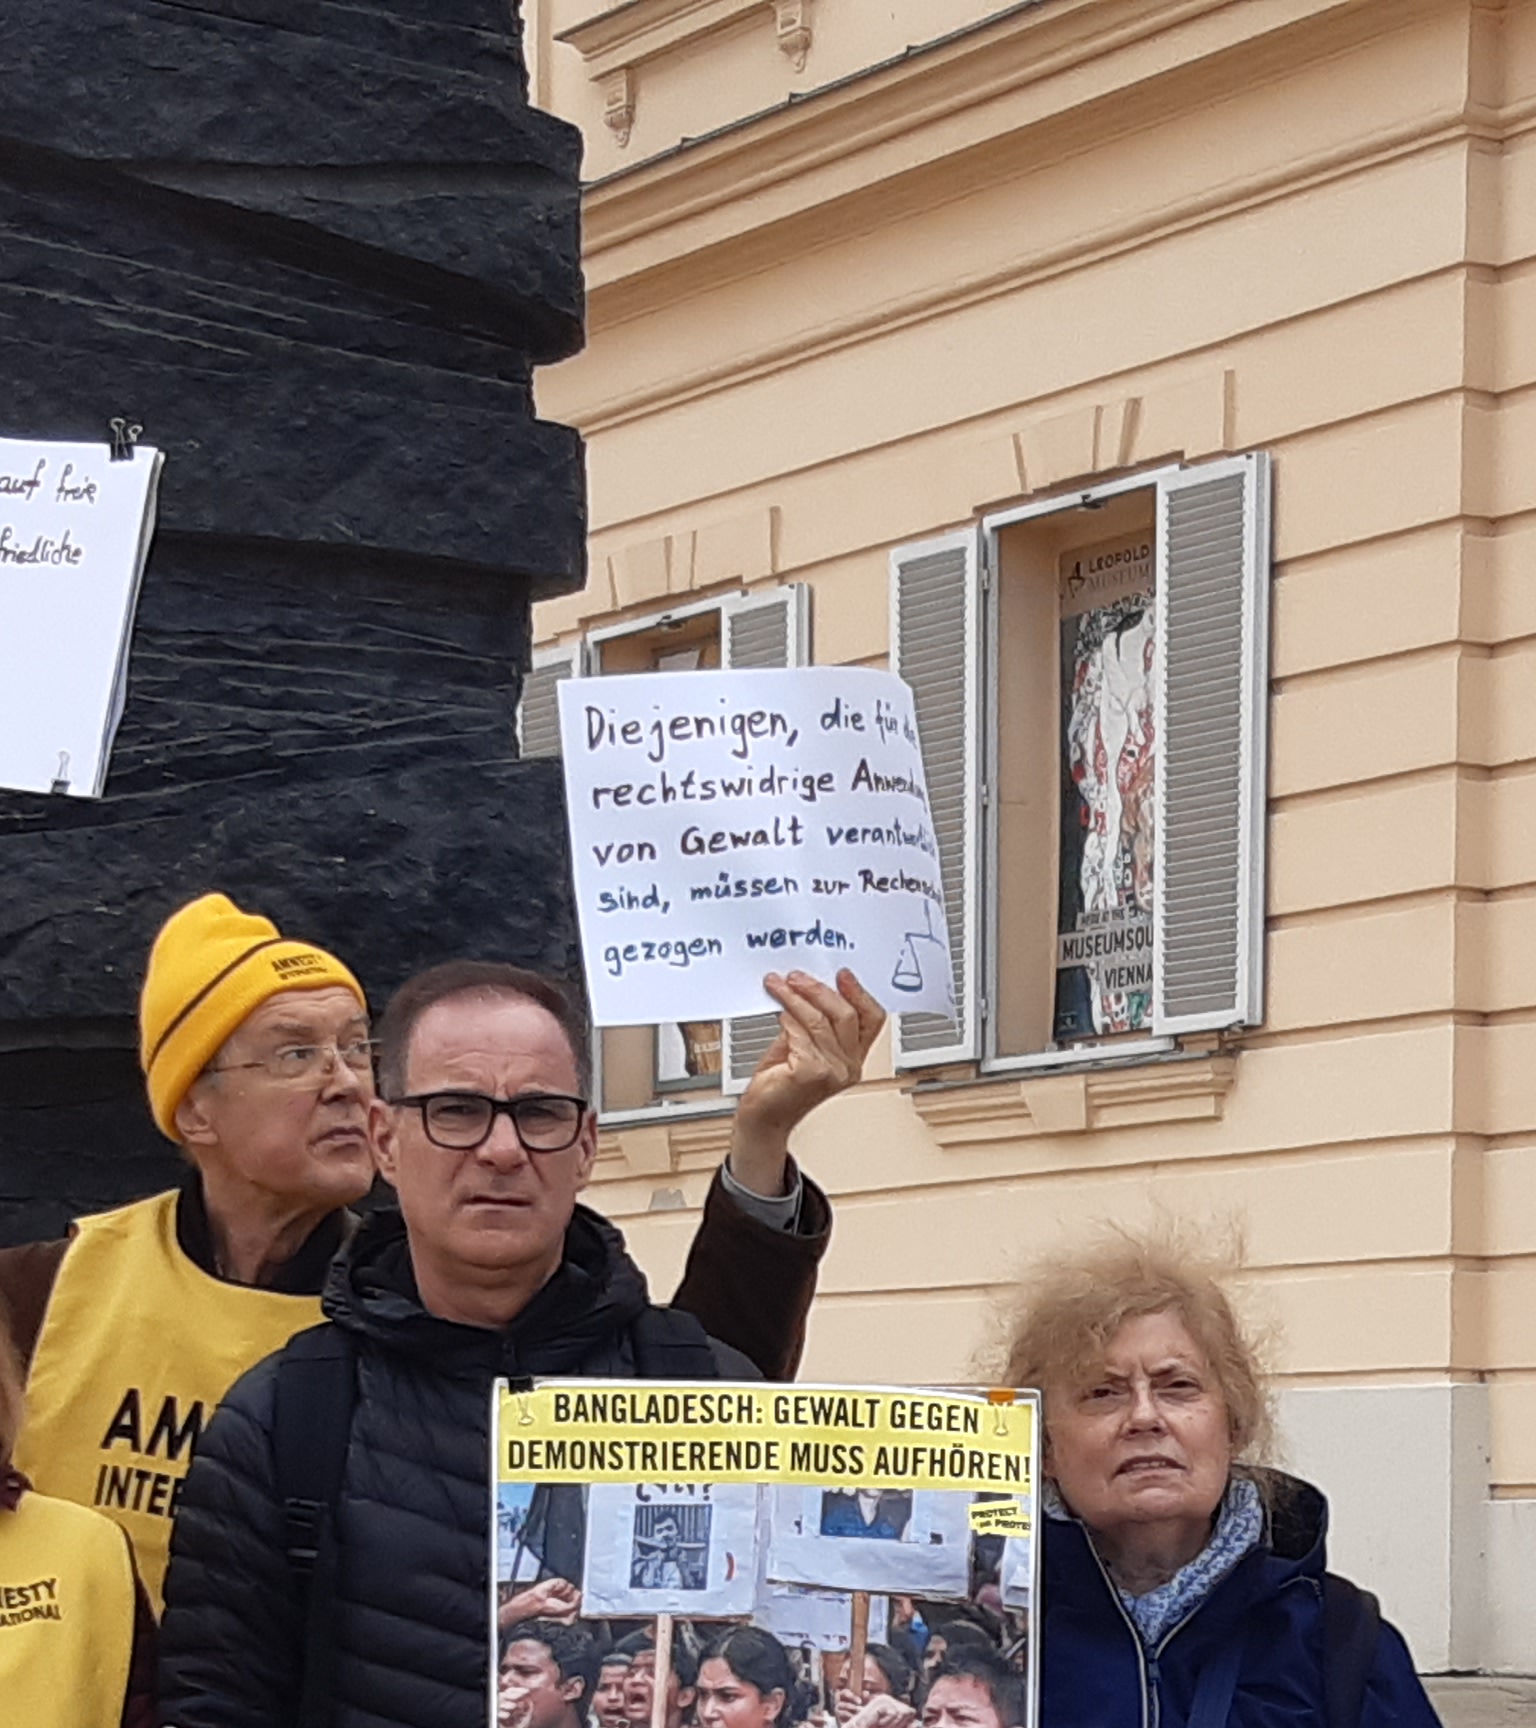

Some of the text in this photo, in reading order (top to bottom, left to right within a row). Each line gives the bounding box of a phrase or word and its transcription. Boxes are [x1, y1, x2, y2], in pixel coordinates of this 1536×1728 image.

[56, 463, 98, 503] freie
[1088, 544, 1150, 575] LEOPOLD
[584, 698, 799, 762] Diejenigen,
[821, 697, 865, 734] die
[875, 699, 899, 745] für
[592, 766, 835, 810] rechtswidrige
[593, 838, 657, 867] von
[681, 816, 804, 858] Gewalt
[597, 883, 671, 915] sind,
[690, 874, 799, 900] müssen
[812, 877, 850, 896] zur
[604, 919, 856, 976] gezogen werden.
[1104, 963, 1154, 989] VIENNA
[100, 1387, 222, 1462] AM
[553, 1394, 979, 1435] BANGLADESCH: GEWALT GEGEN
[507, 1440, 1031, 1484] DEMONSTRIERENDE MUSS AUFHÖREN!
[93, 1463, 182, 1519] INTE
